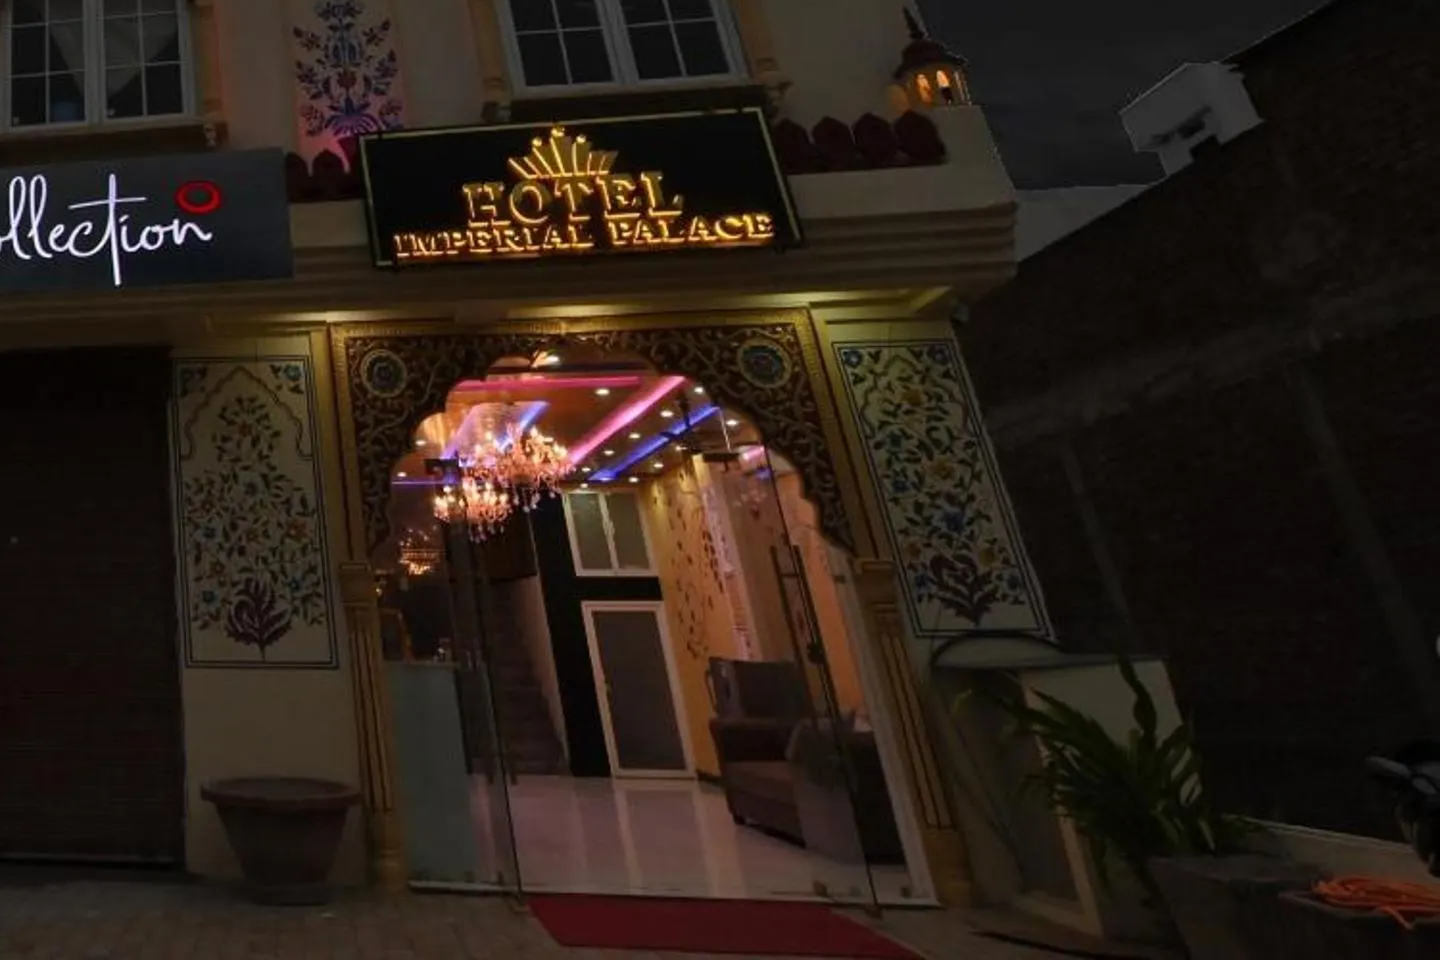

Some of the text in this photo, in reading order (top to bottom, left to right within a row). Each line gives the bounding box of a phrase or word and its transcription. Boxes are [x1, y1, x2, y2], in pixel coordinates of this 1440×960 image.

[462, 170, 684, 228] HOTEL
[393, 211, 775, 258] IMPERIAL PALACE
